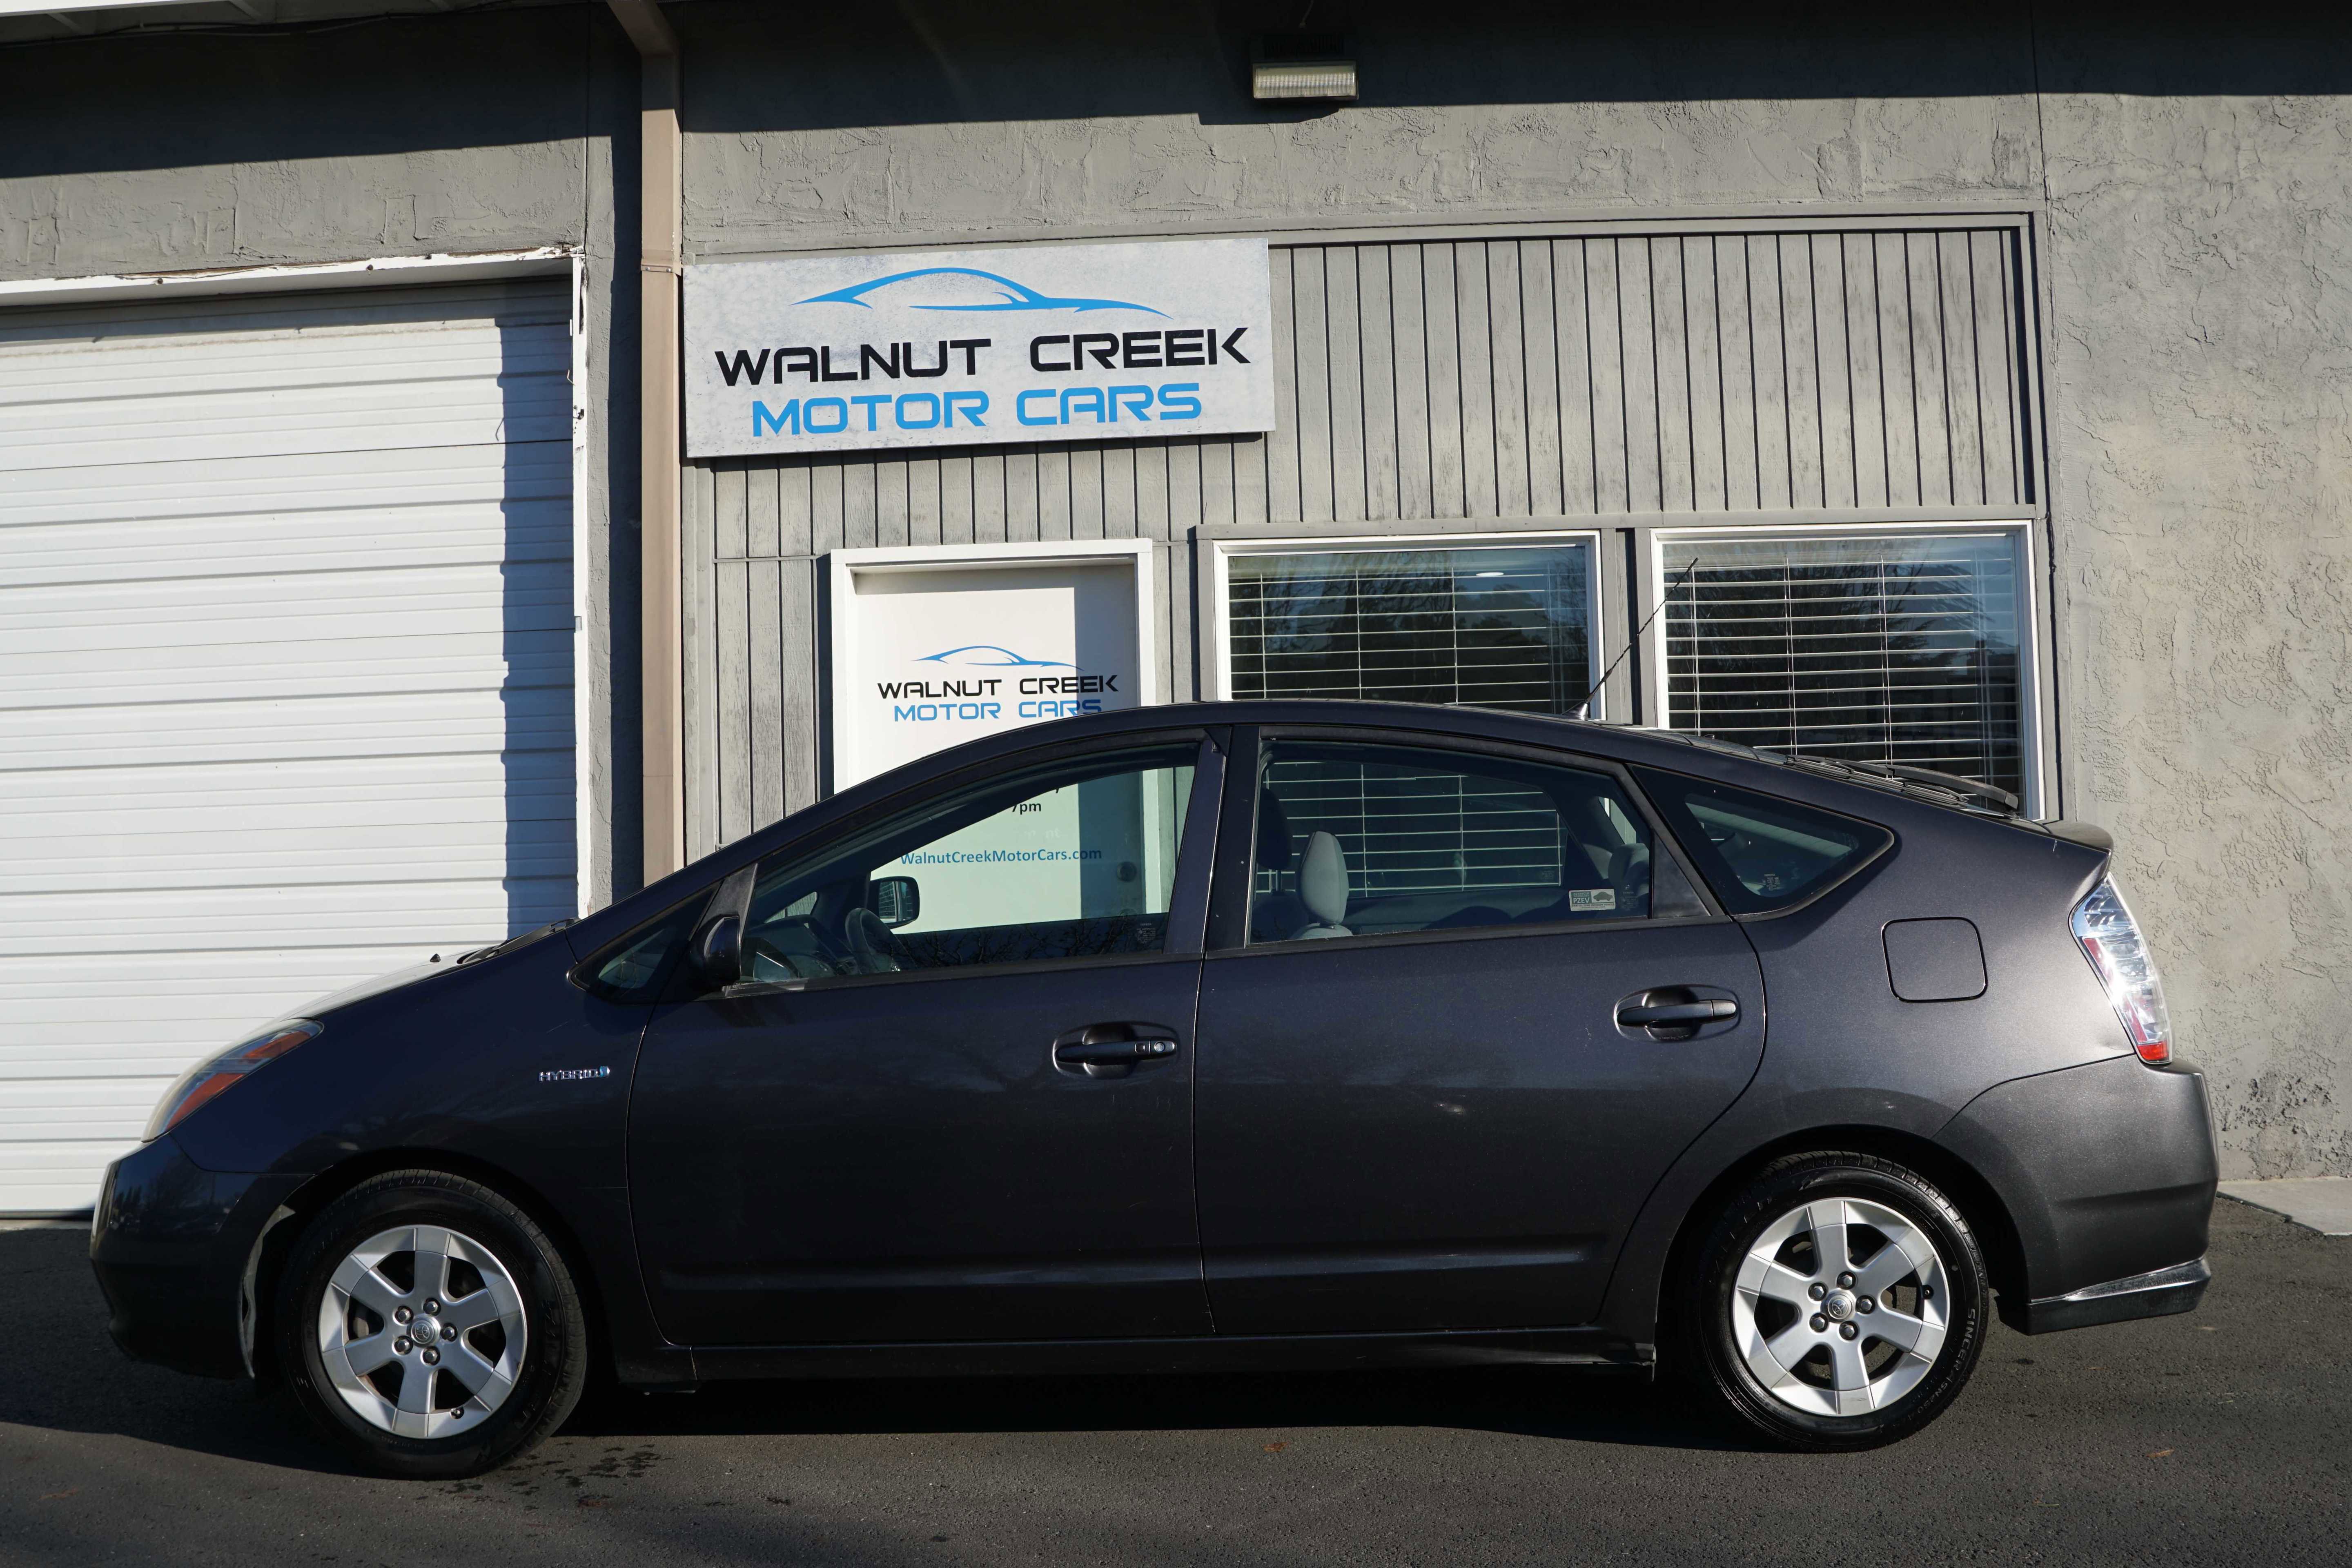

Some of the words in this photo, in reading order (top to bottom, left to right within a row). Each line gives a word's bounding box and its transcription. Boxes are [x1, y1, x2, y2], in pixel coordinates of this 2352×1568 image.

[715, 339, 991, 387] WALNUT
[1030, 327, 1251, 372] CREEK
[752, 390, 989, 437] MOTOR
[1016, 383, 1202, 426] CARS
[878, 679, 1002, 699] WALNUT
[1019, 675, 1119, 695] CREEK
[894, 702, 1001, 722] MOTOR
[1018, 699, 1102, 718] CARS
[901, 849, 1102, 865] WalnutCreekMotorCars.com
[539, 1069, 599, 1082] HYBRID
